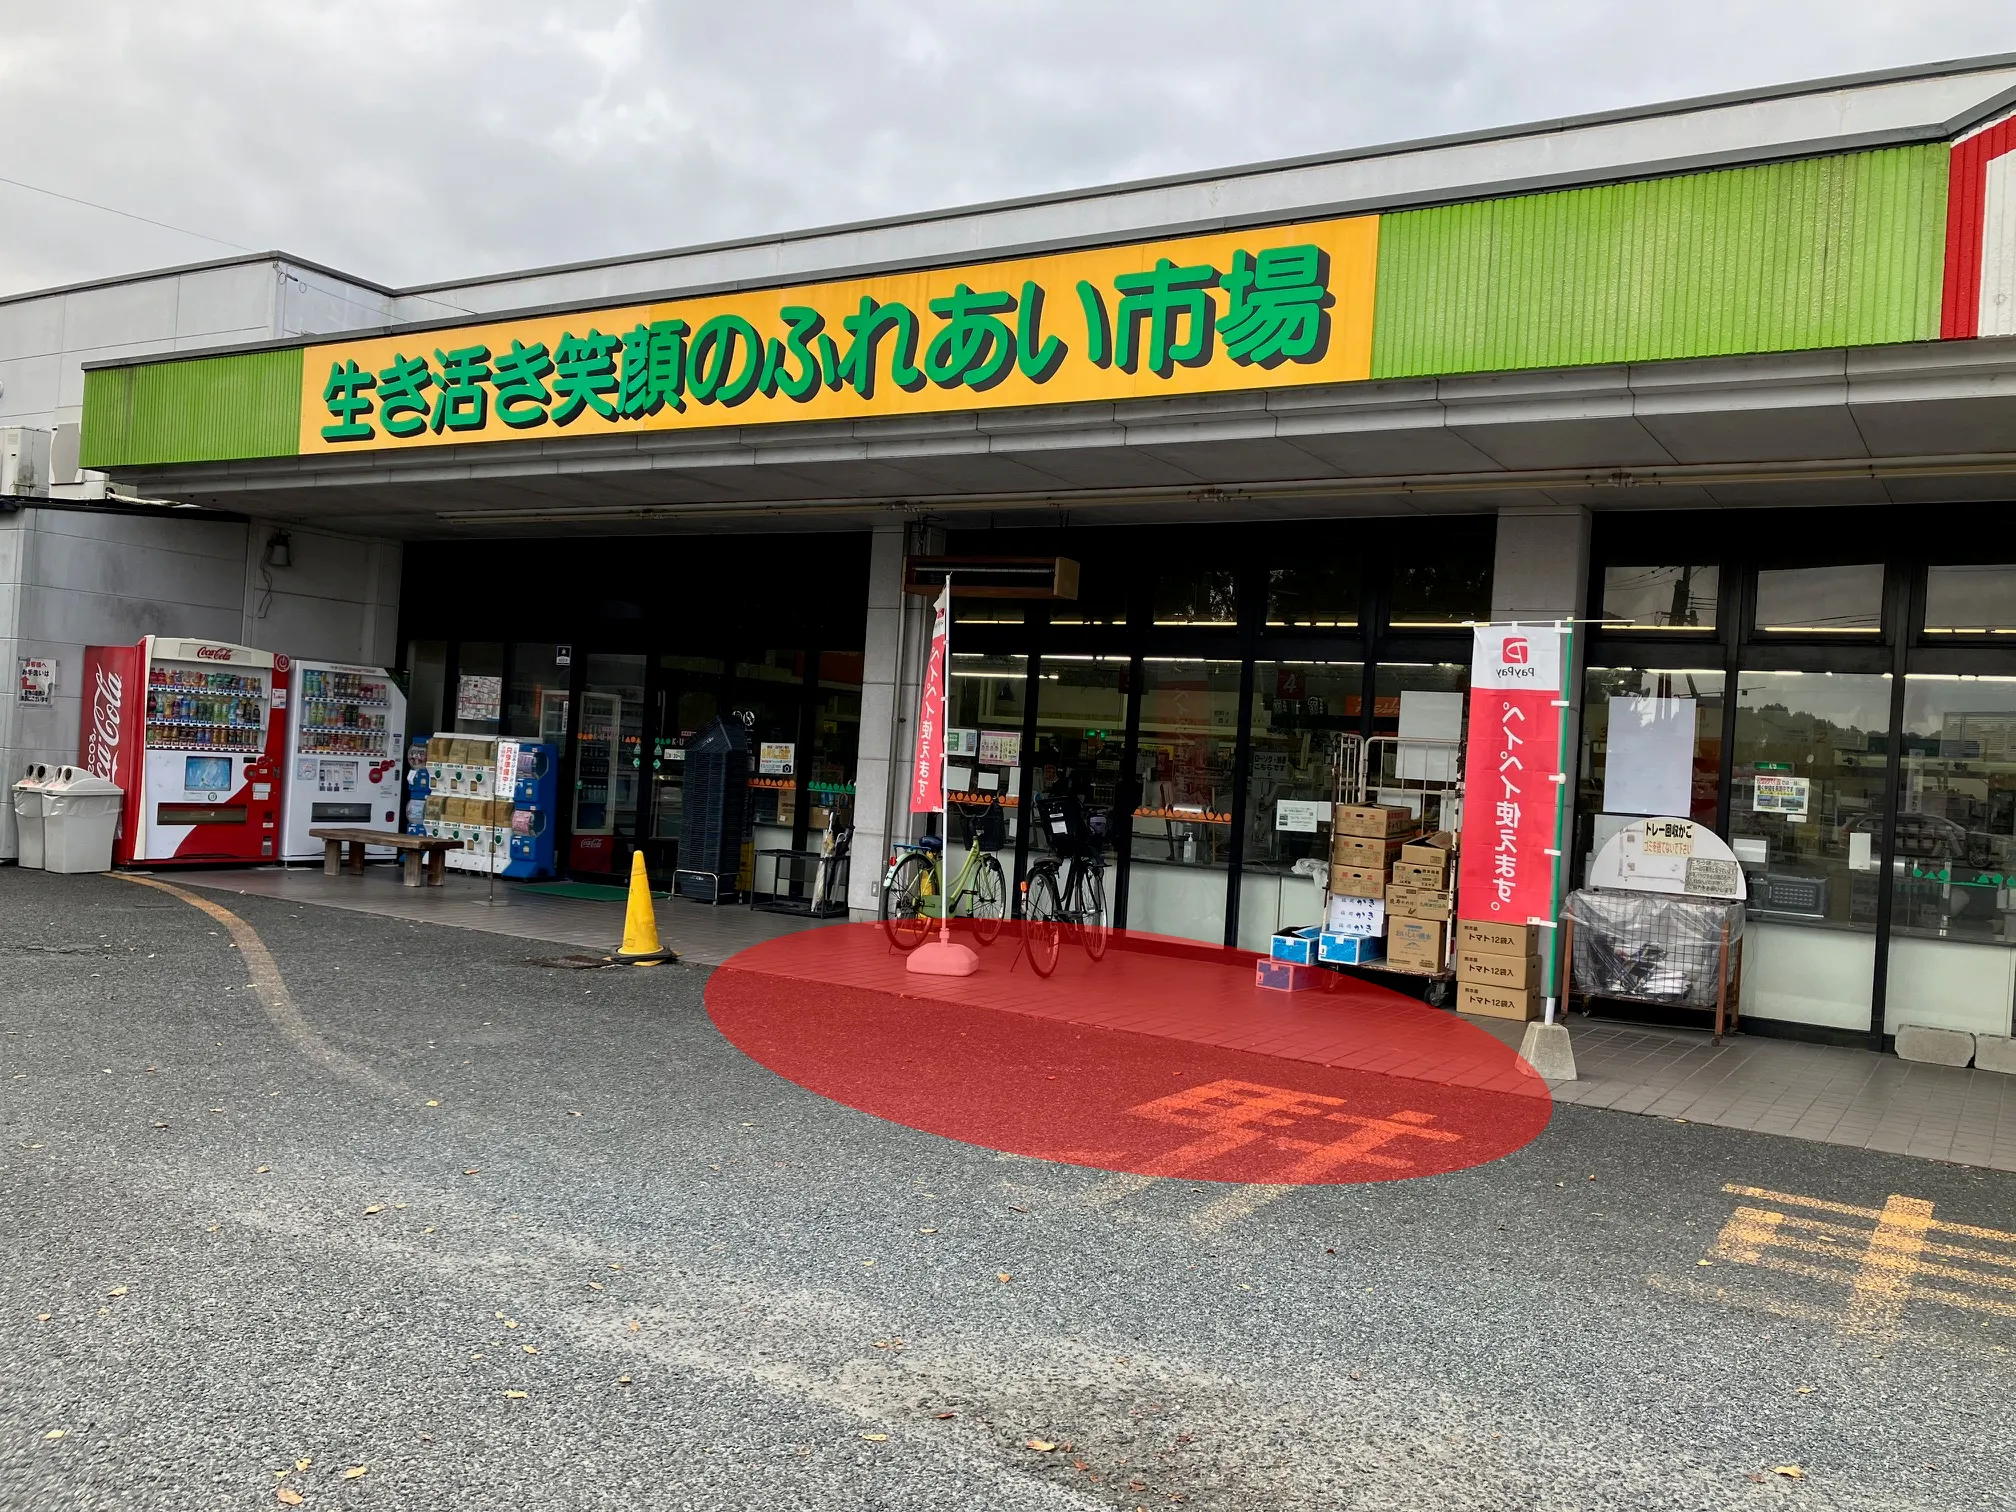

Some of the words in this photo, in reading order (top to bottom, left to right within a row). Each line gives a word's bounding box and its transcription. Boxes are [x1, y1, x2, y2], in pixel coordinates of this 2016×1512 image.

[320, 244, 1336, 442] 生き活き笑顔のふれあい市場
[197, 646, 233, 661] Coca-Cola
[94, 662, 123, 782] ca-Cola
[1254, 763, 1286, 771] こちらです
[1646, 822, 1693, 839] トレー回収かご
[1469, 933, 1515, 945] トマト12袋入
[1469, 964, 1514, 977] トマト12袋入
[1469, 995, 1515, 1008] トマト12袋入
